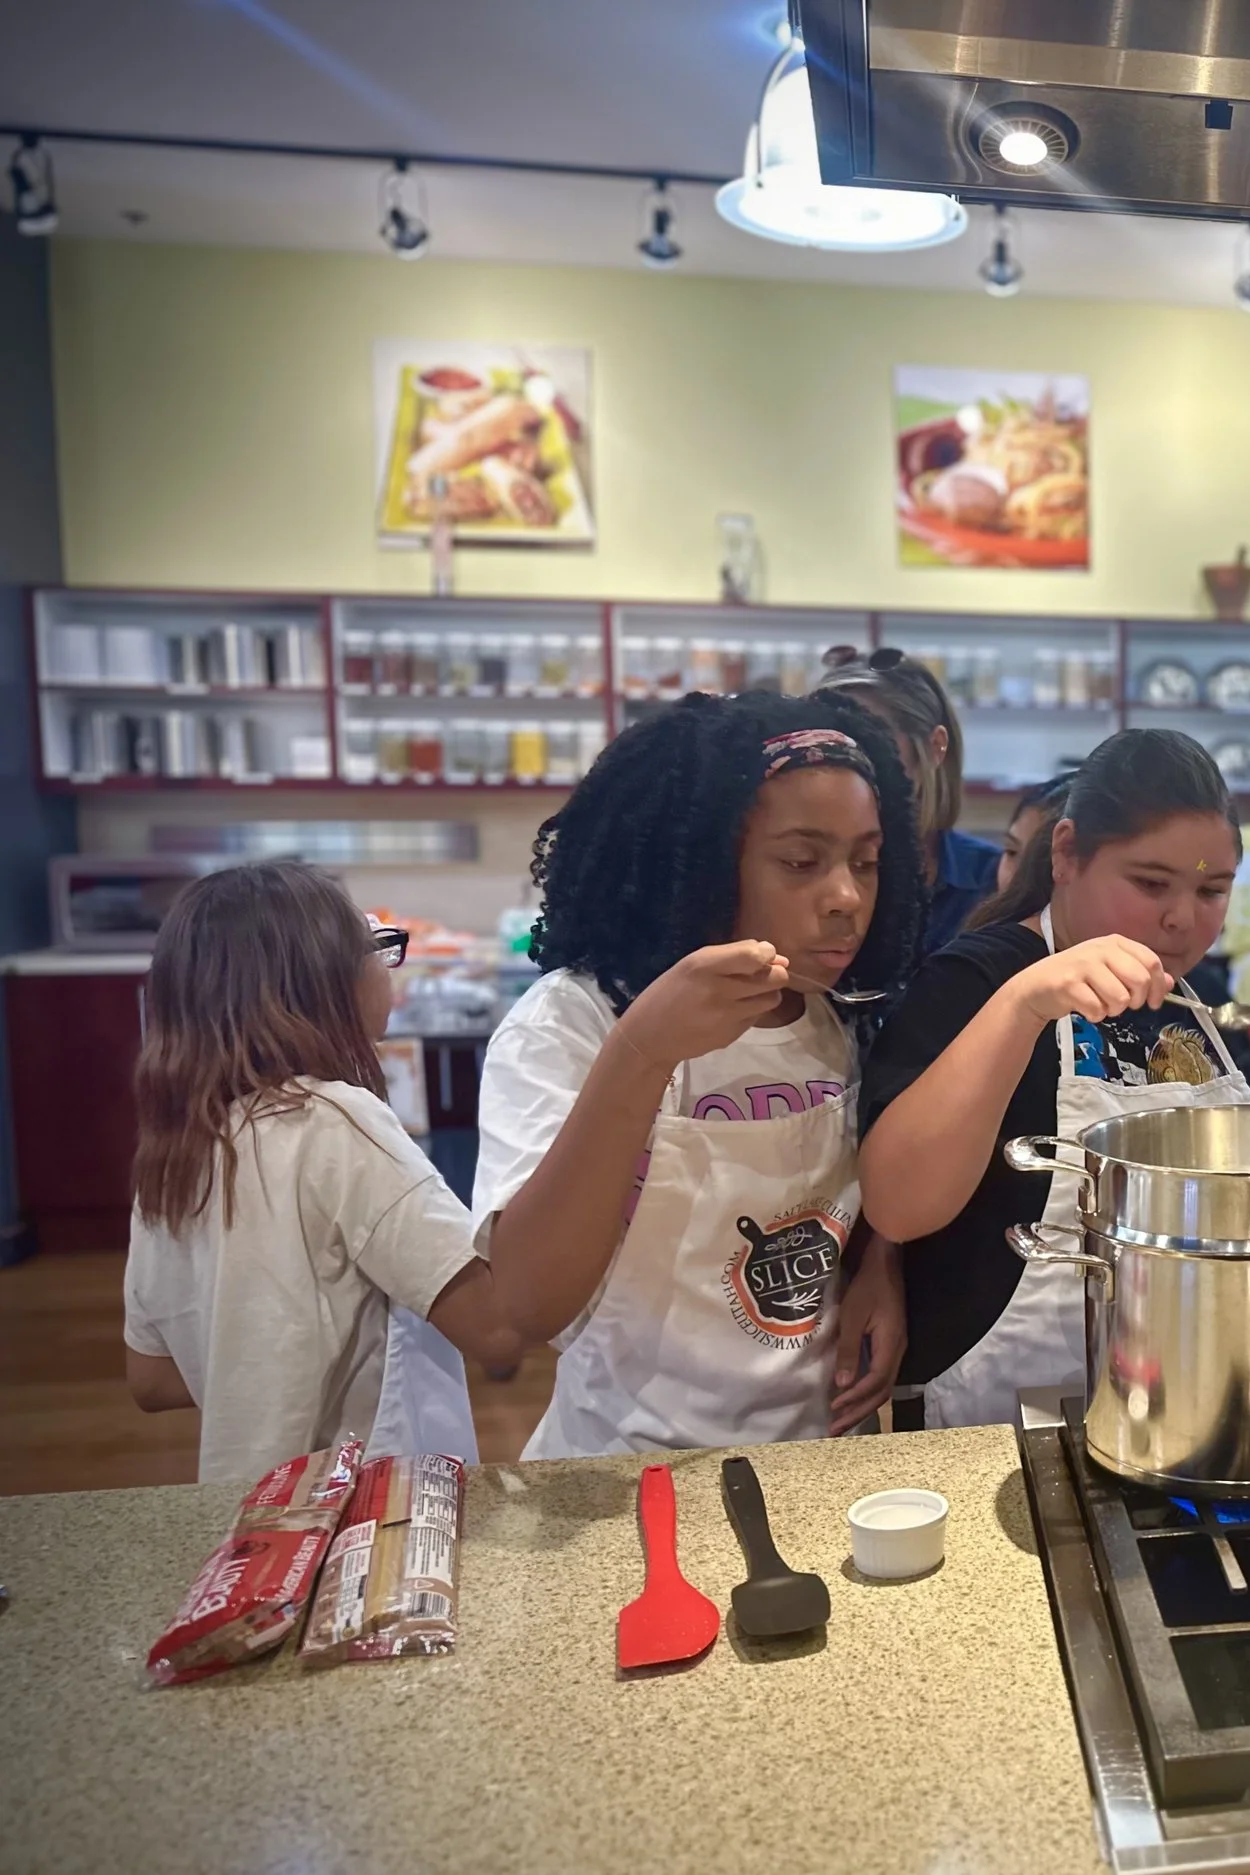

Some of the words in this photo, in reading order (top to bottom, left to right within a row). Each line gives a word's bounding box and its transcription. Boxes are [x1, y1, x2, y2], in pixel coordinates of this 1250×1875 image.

[750, 1246, 835, 1293] SLICE
[292, 1535, 321, 1562] BEAUTY
[191, 1557, 251, 1623] BEAUTY
